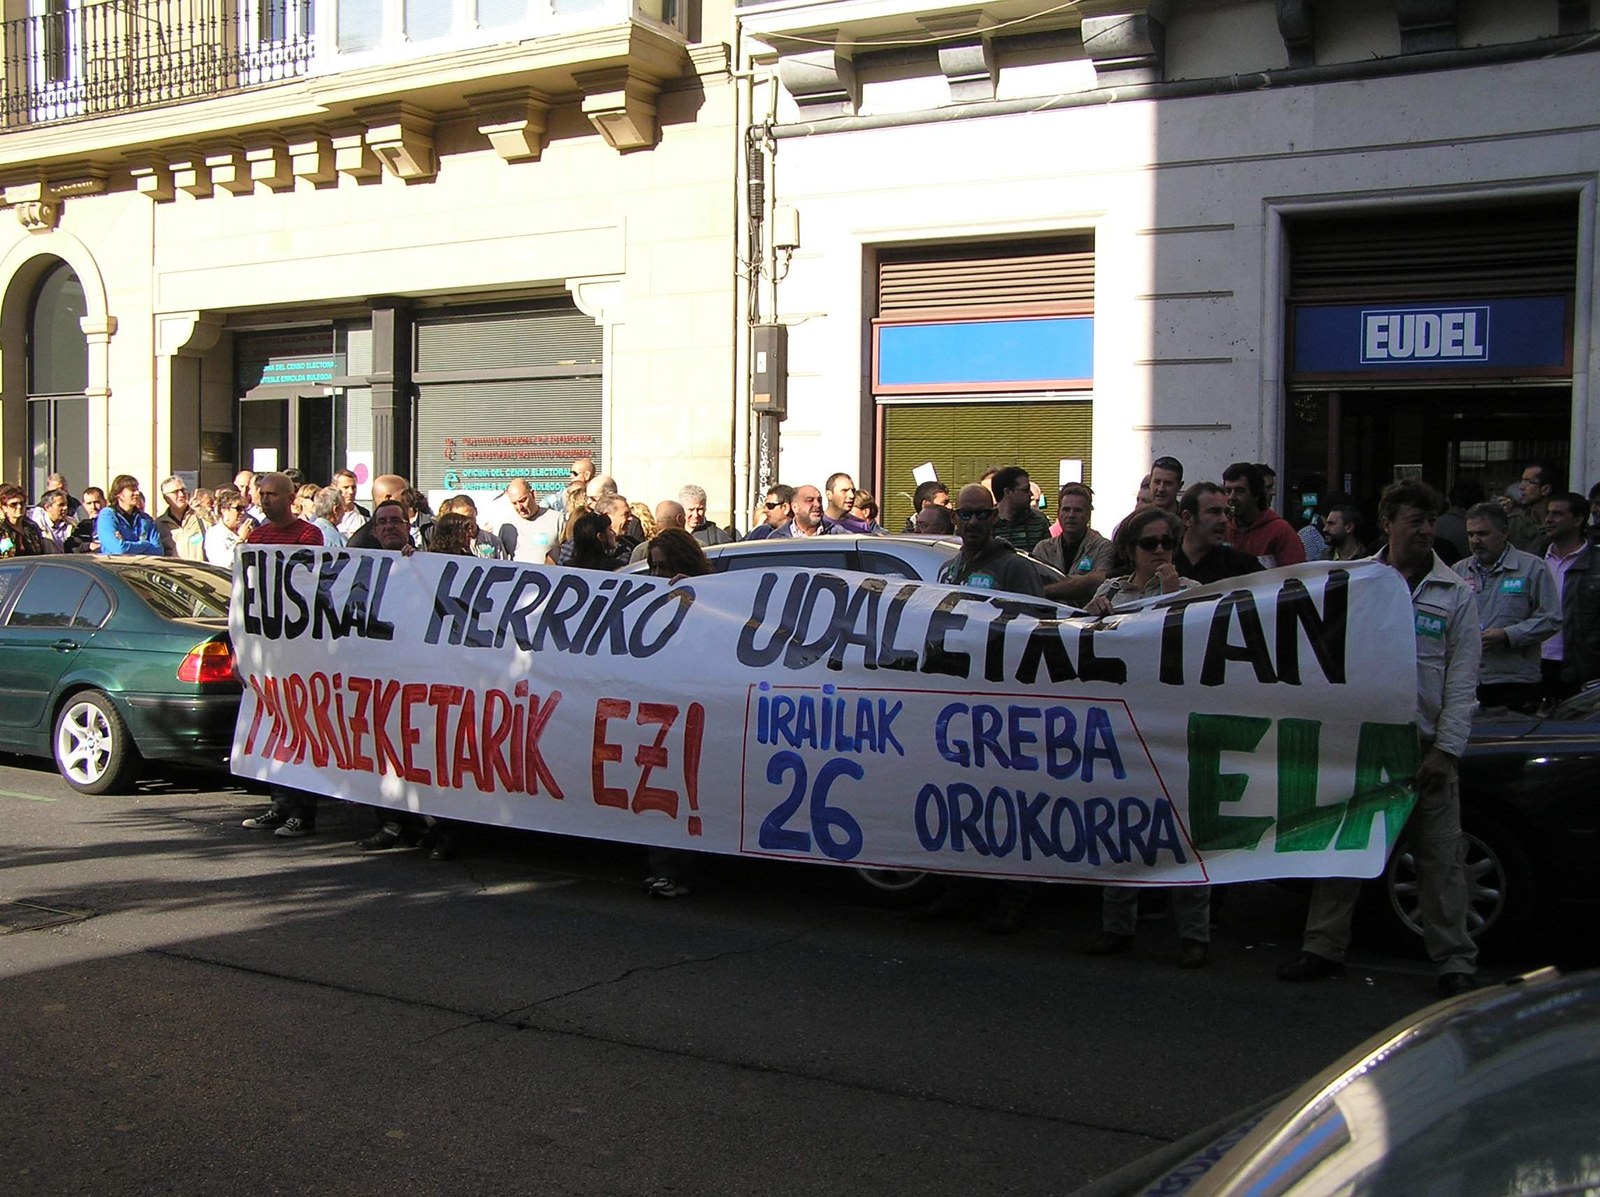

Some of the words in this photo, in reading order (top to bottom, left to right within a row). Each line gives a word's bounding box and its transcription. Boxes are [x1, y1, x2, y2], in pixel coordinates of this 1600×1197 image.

[1366, 312, 1483, 358] EUDEL
[241, 549, 395, 641] EUSKAL
[591, 697, 706, 837] EZ!
[935, 703, 1127, 782] GREBA
[1187, 712, 1420, 853] ELA
[758, 750, 864, 861] 26
[914, 782, 1187, 866] OROKORRA
